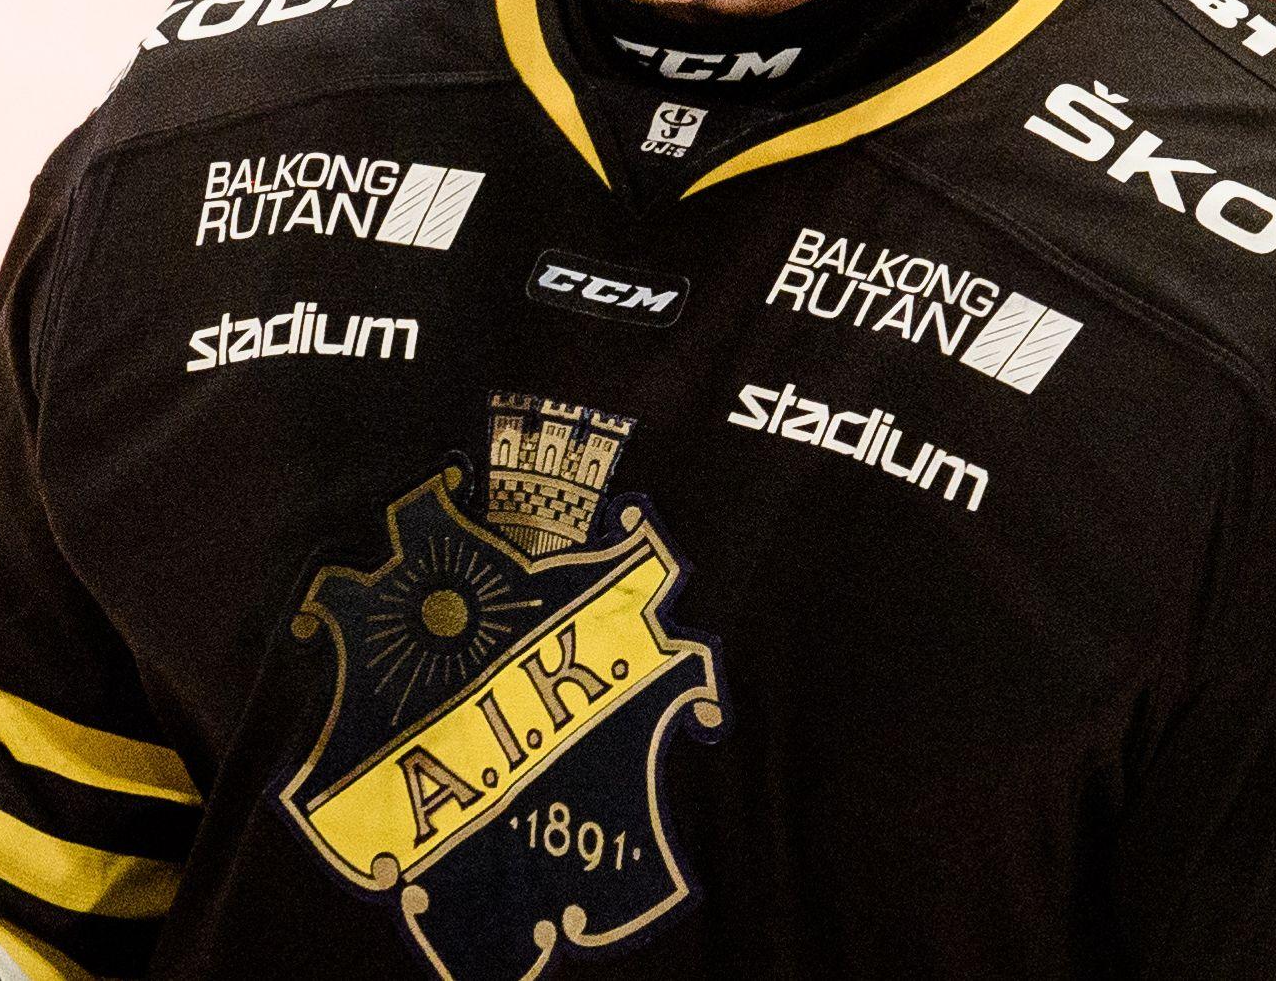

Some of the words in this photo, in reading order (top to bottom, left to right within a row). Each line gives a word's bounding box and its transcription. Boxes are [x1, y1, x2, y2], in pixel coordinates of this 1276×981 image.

[205, 152, 399, 200] BALKONG
[196, 189, 378, 246] RUTAN
[538, 264, 679, 312] CCM
[787, 227, 1000, 318] BALKONG
[187, 302, 418, 372] stadium
[765, 263, 972, 356] RUTAN
[727, 383, 989, 512] stadium
